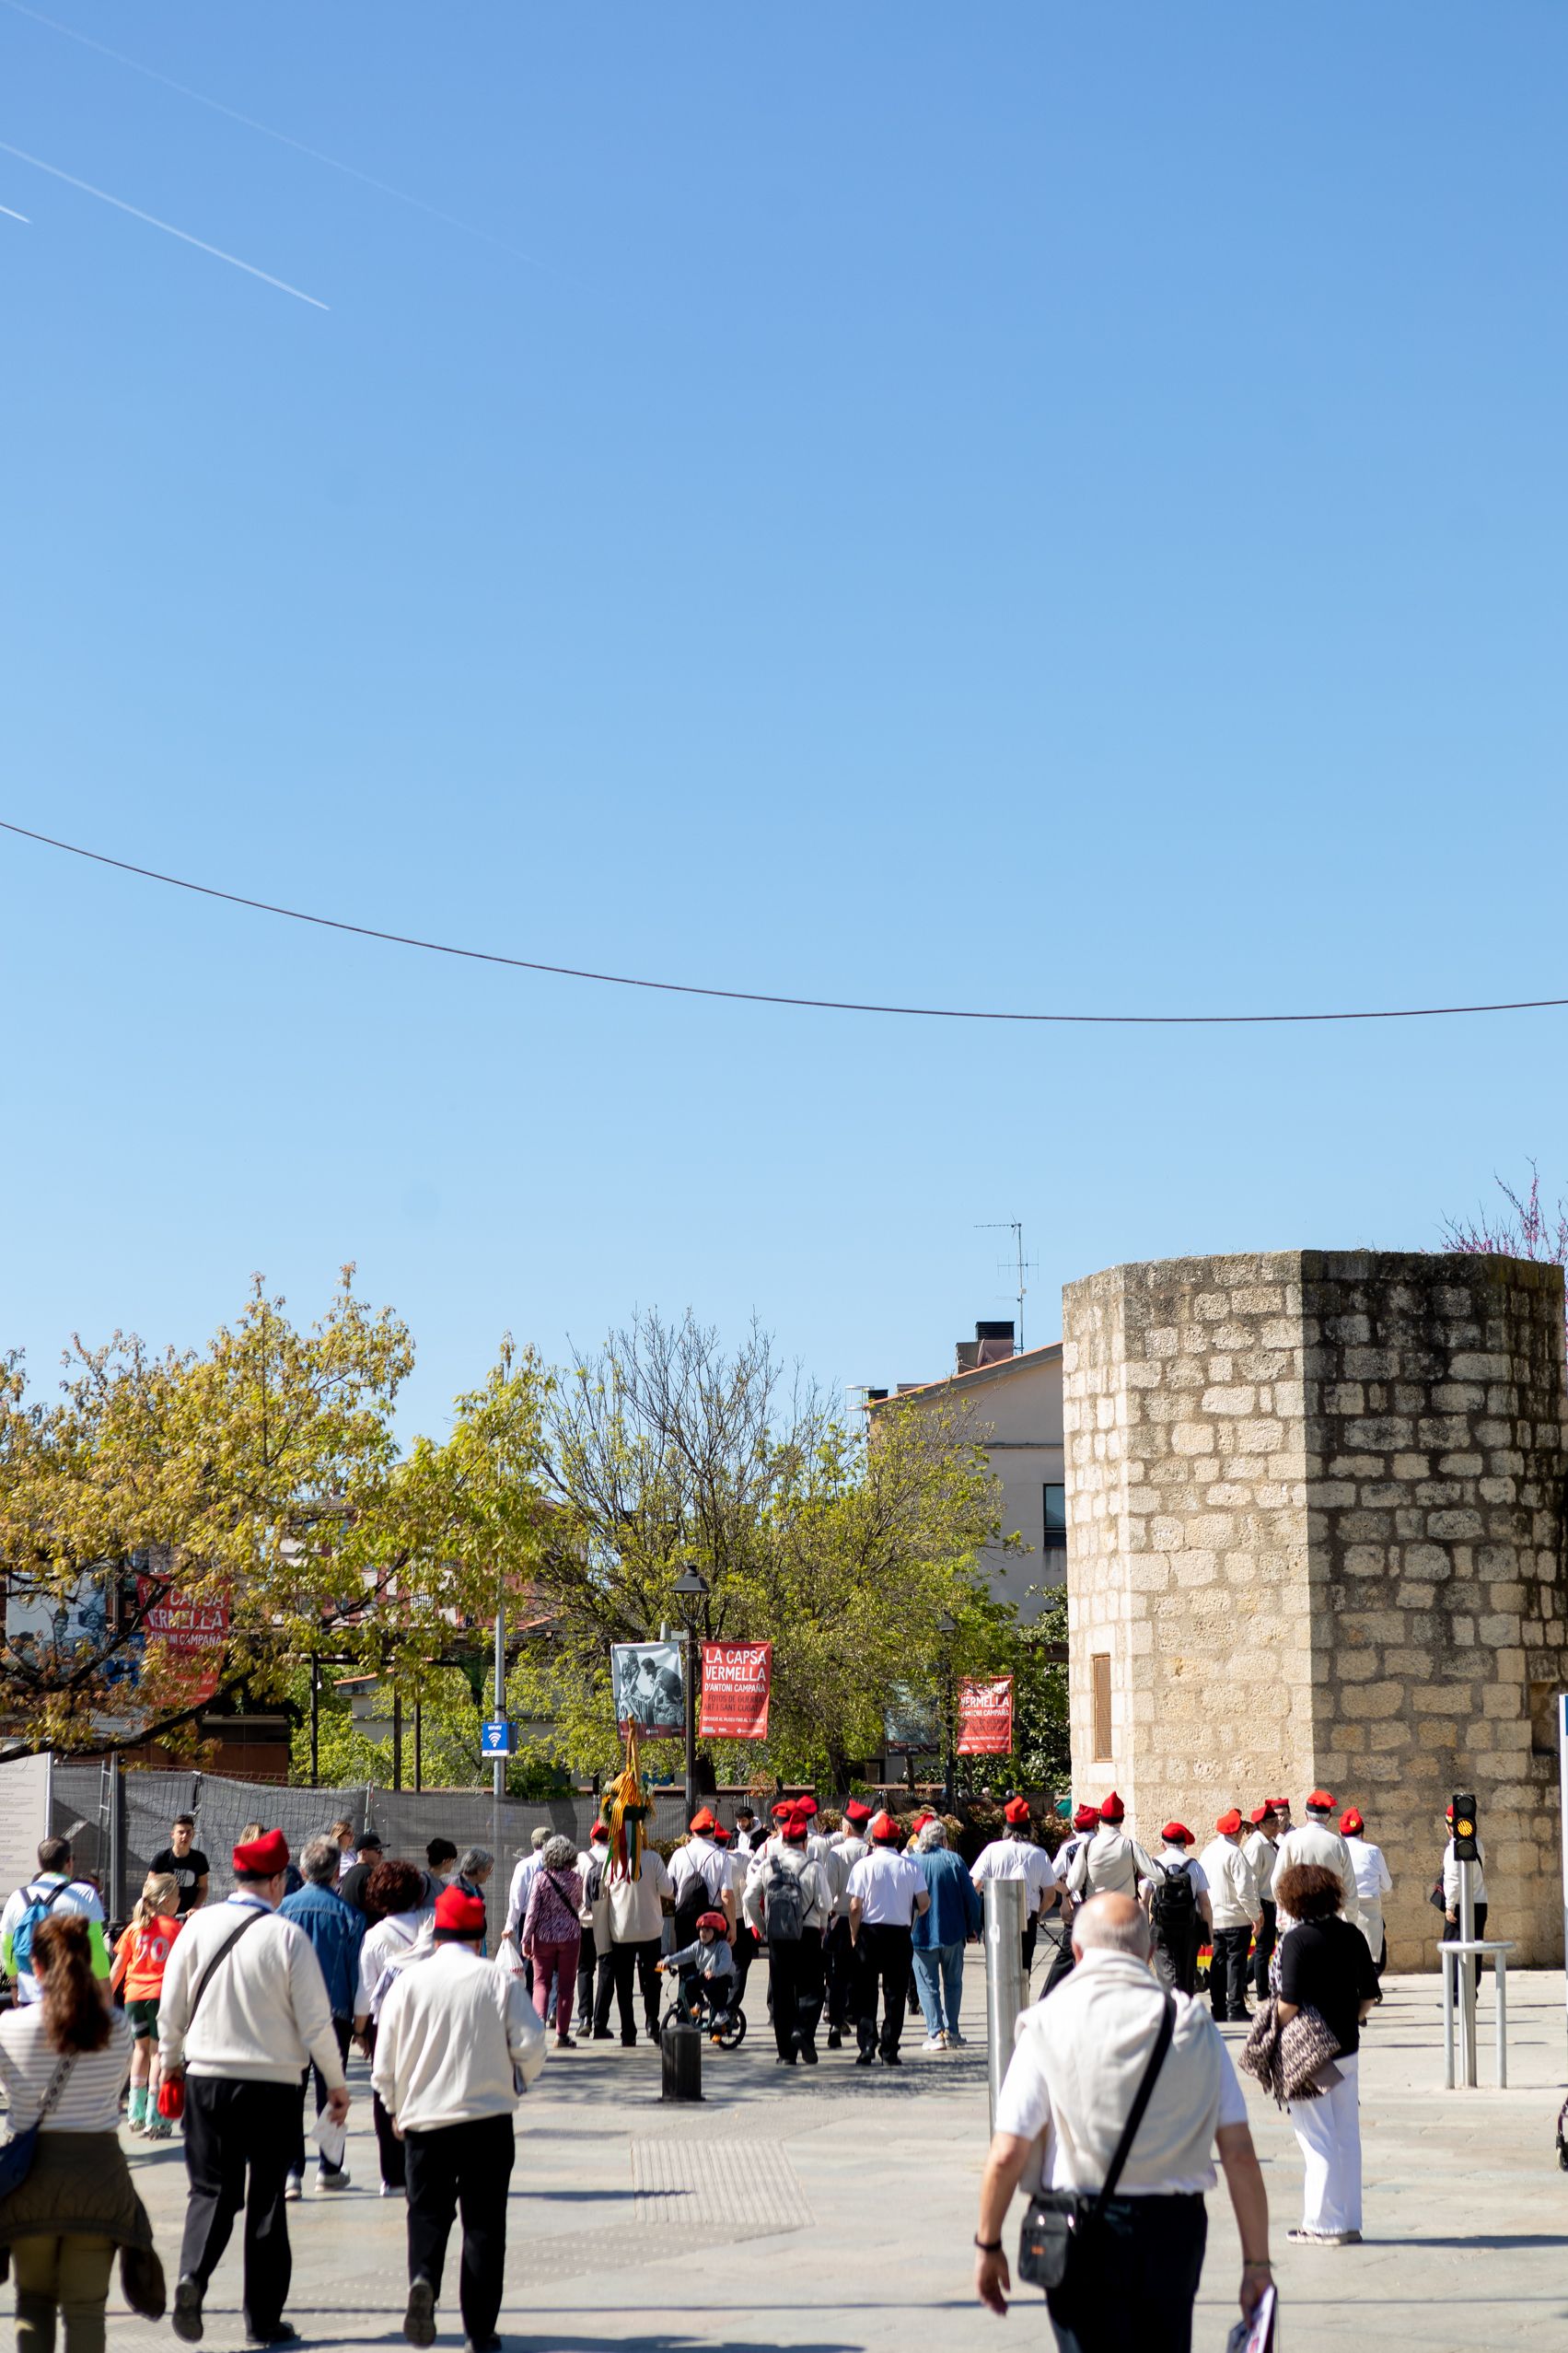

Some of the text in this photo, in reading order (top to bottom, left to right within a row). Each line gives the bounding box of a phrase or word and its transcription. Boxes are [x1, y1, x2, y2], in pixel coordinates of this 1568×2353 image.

[180, 1633, 222, 1647] CAMPAÑA
[706, 1649, 766, 1664] LA CAPSA
[705, 1666, 765, 1681] VERMELLA
[704, 1683, 765, 1693] D'ANTONI CAMPAÑA
[708, 1695, 726, 1703] FOTOS
[728, 1695, 736, 1703] DE
[704, 1703, 714, 1711] ART
[721, 1704, 736, 1712] SANT
